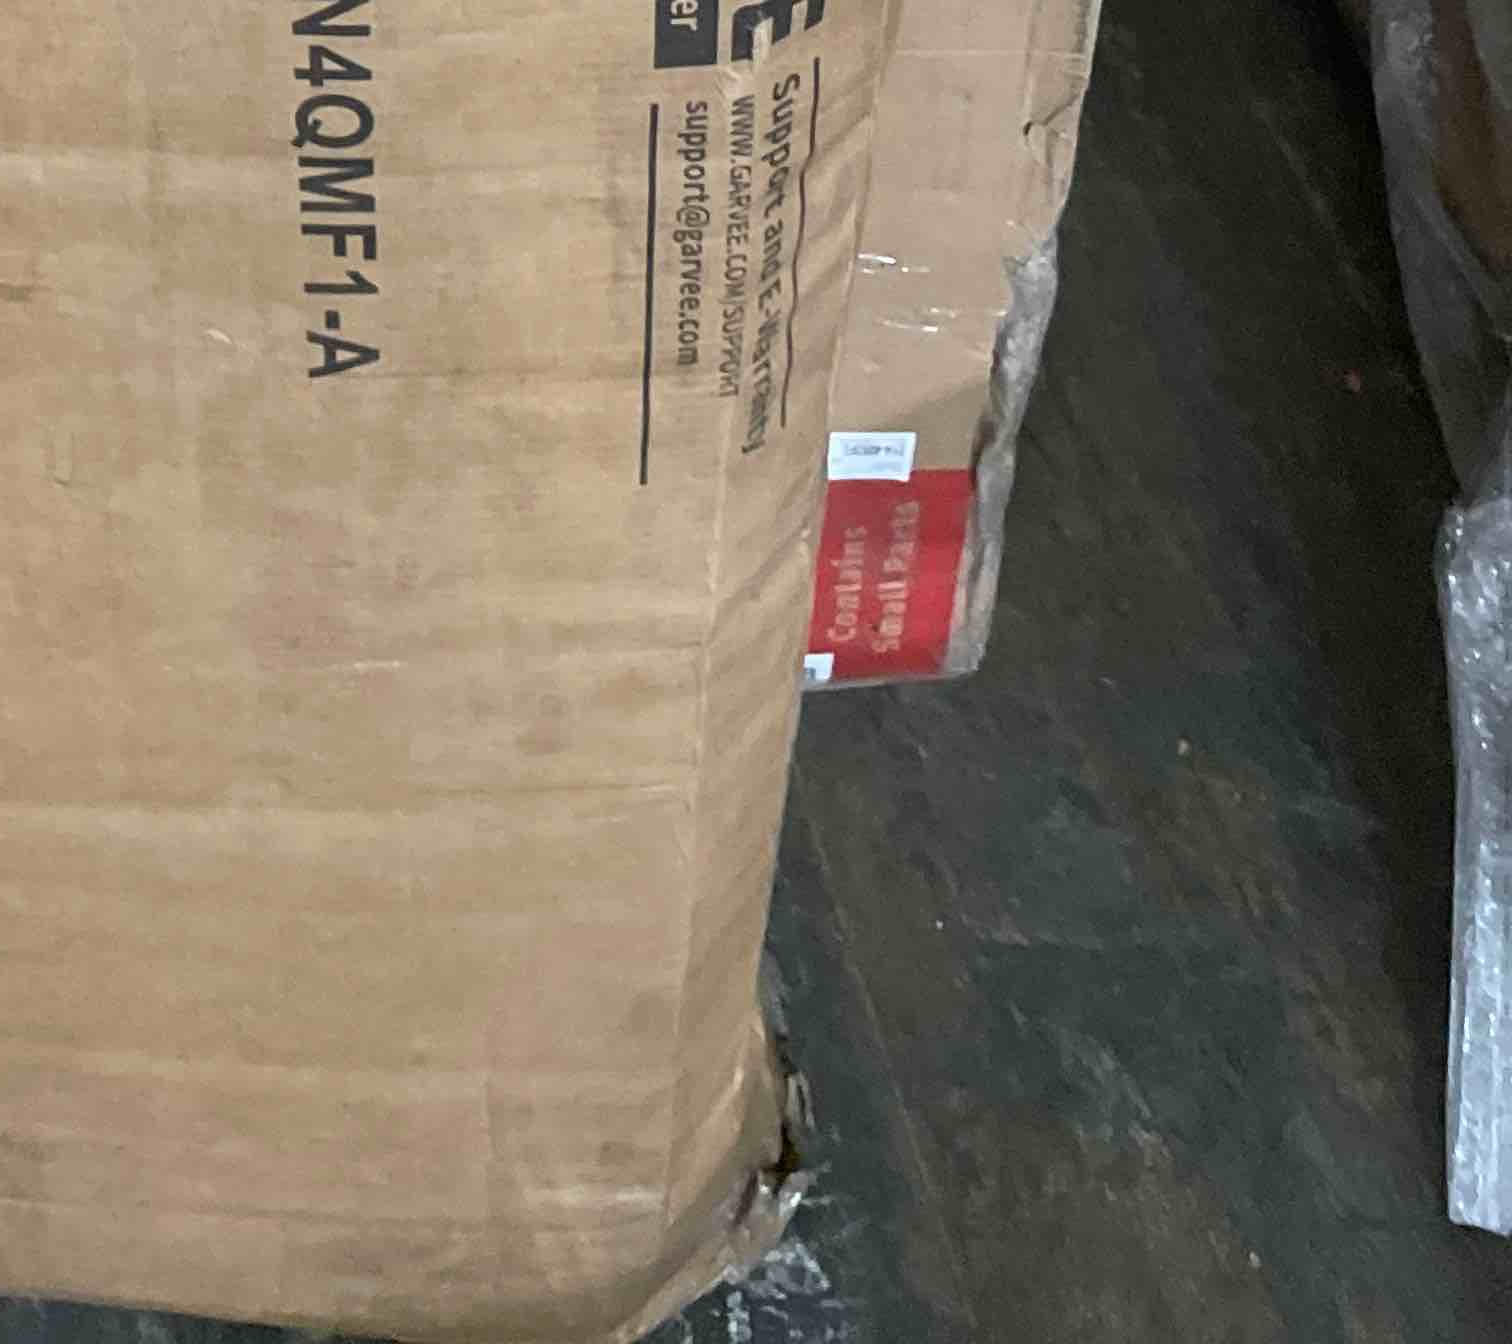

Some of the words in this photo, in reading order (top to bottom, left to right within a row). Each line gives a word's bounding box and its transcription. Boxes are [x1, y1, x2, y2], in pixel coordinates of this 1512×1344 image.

[762, 72, 801, 219] Support
[673, 100, 711, 366] support@garvee.com
[719, 94, 755, 398] WWW.GARVEE.COM/SUPPORT
[761, 221, 785, 280] and
[827, 525, 867, 643] Contains
[884, 500, 920, 571] Parts
[871, 580, 908, 653] Small
